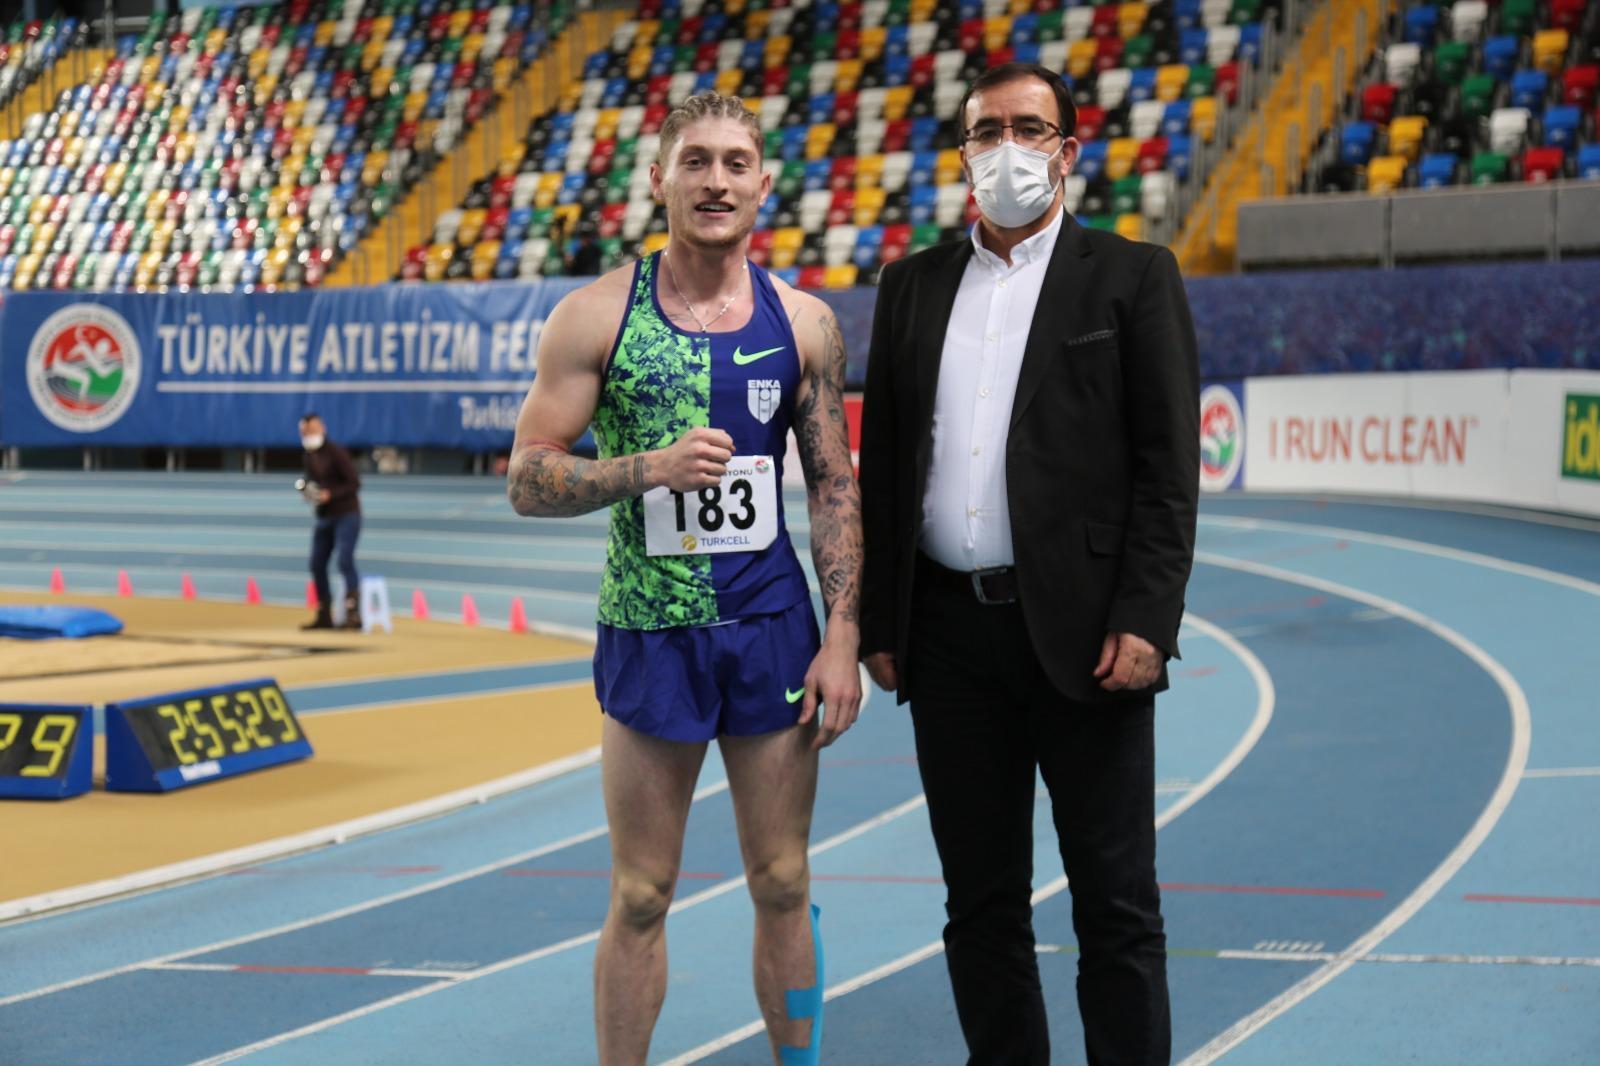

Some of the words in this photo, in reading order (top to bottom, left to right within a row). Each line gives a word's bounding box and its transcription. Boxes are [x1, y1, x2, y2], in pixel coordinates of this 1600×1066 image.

[157, 313, 308, 374] TÜRKİYE
[317, 309, 480, 373] ATLETİZM
[747, 379, 781, 389] ENKA
[1269, 416, 1278, 462] I
[1284, 415, 1353, 462] RUN
[669, 478, 756, 533] 183
[701, 536, 751, 546] TURKCELL
[157, 686, 298, 764] 2:55:29
